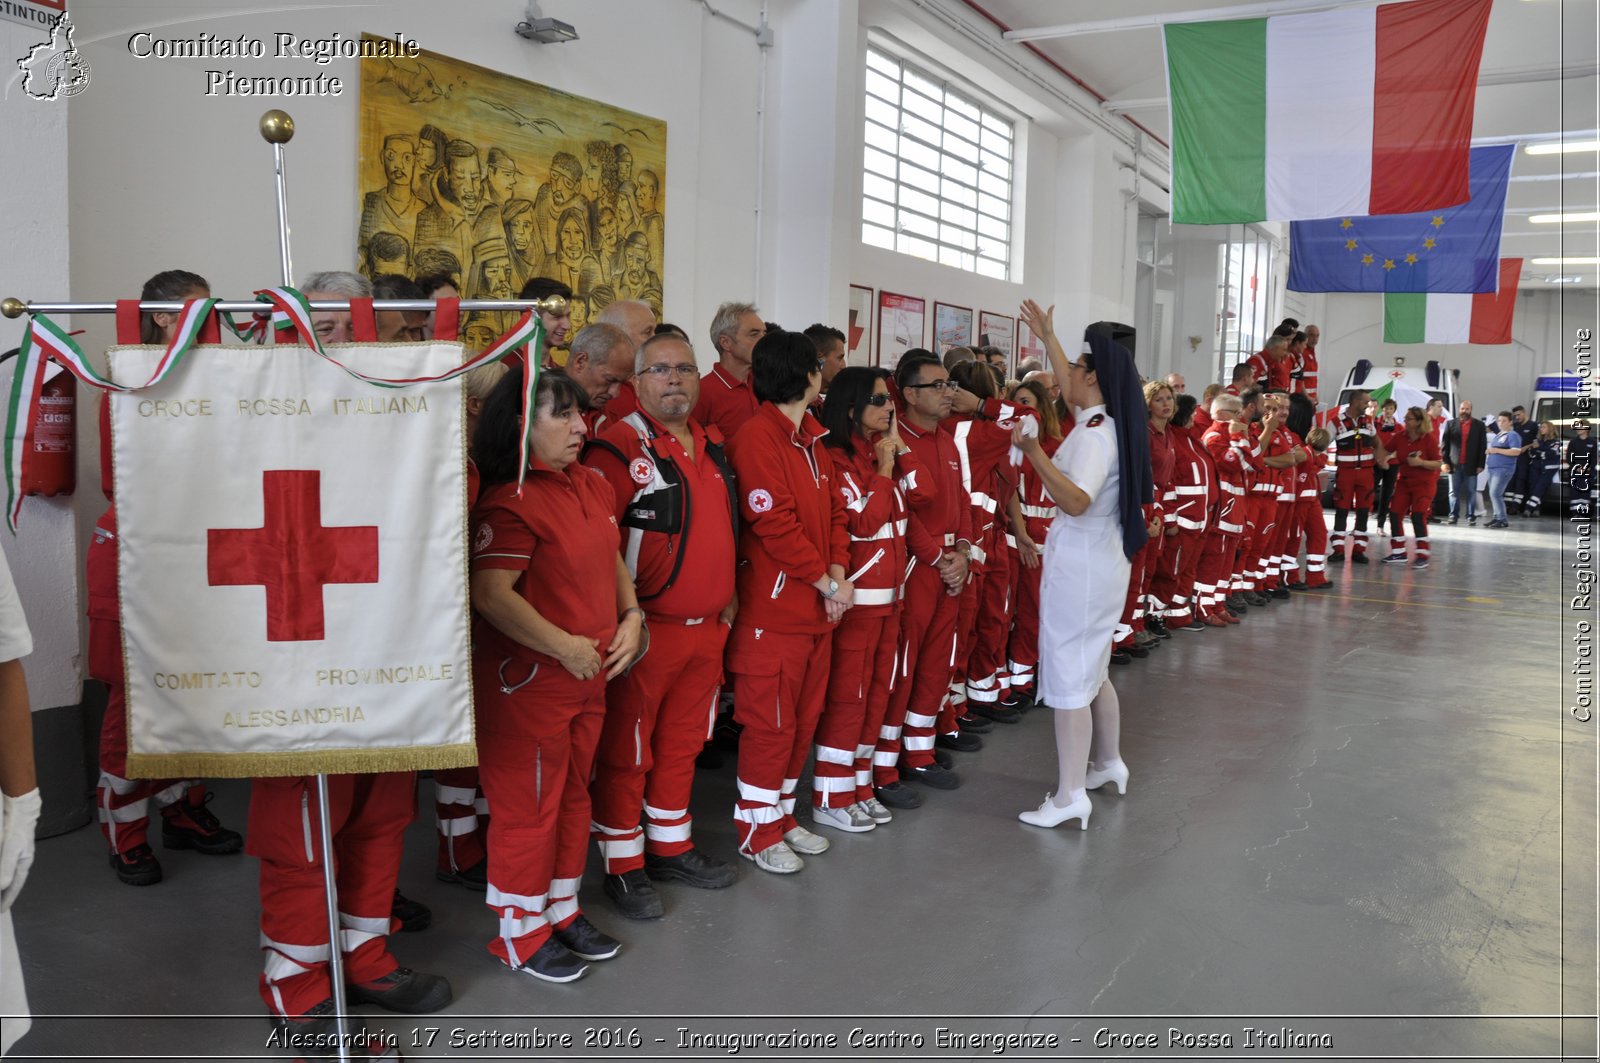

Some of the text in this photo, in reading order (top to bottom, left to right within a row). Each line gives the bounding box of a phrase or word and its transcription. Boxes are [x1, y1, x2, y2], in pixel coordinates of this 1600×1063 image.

[138, 395, 429, 418] CROCE ROSSA ITALIANA
[153, 664, 454, 691] COMITATO PROVINCIALE
[222, 706, 366, 729] ALESSANDRIA
